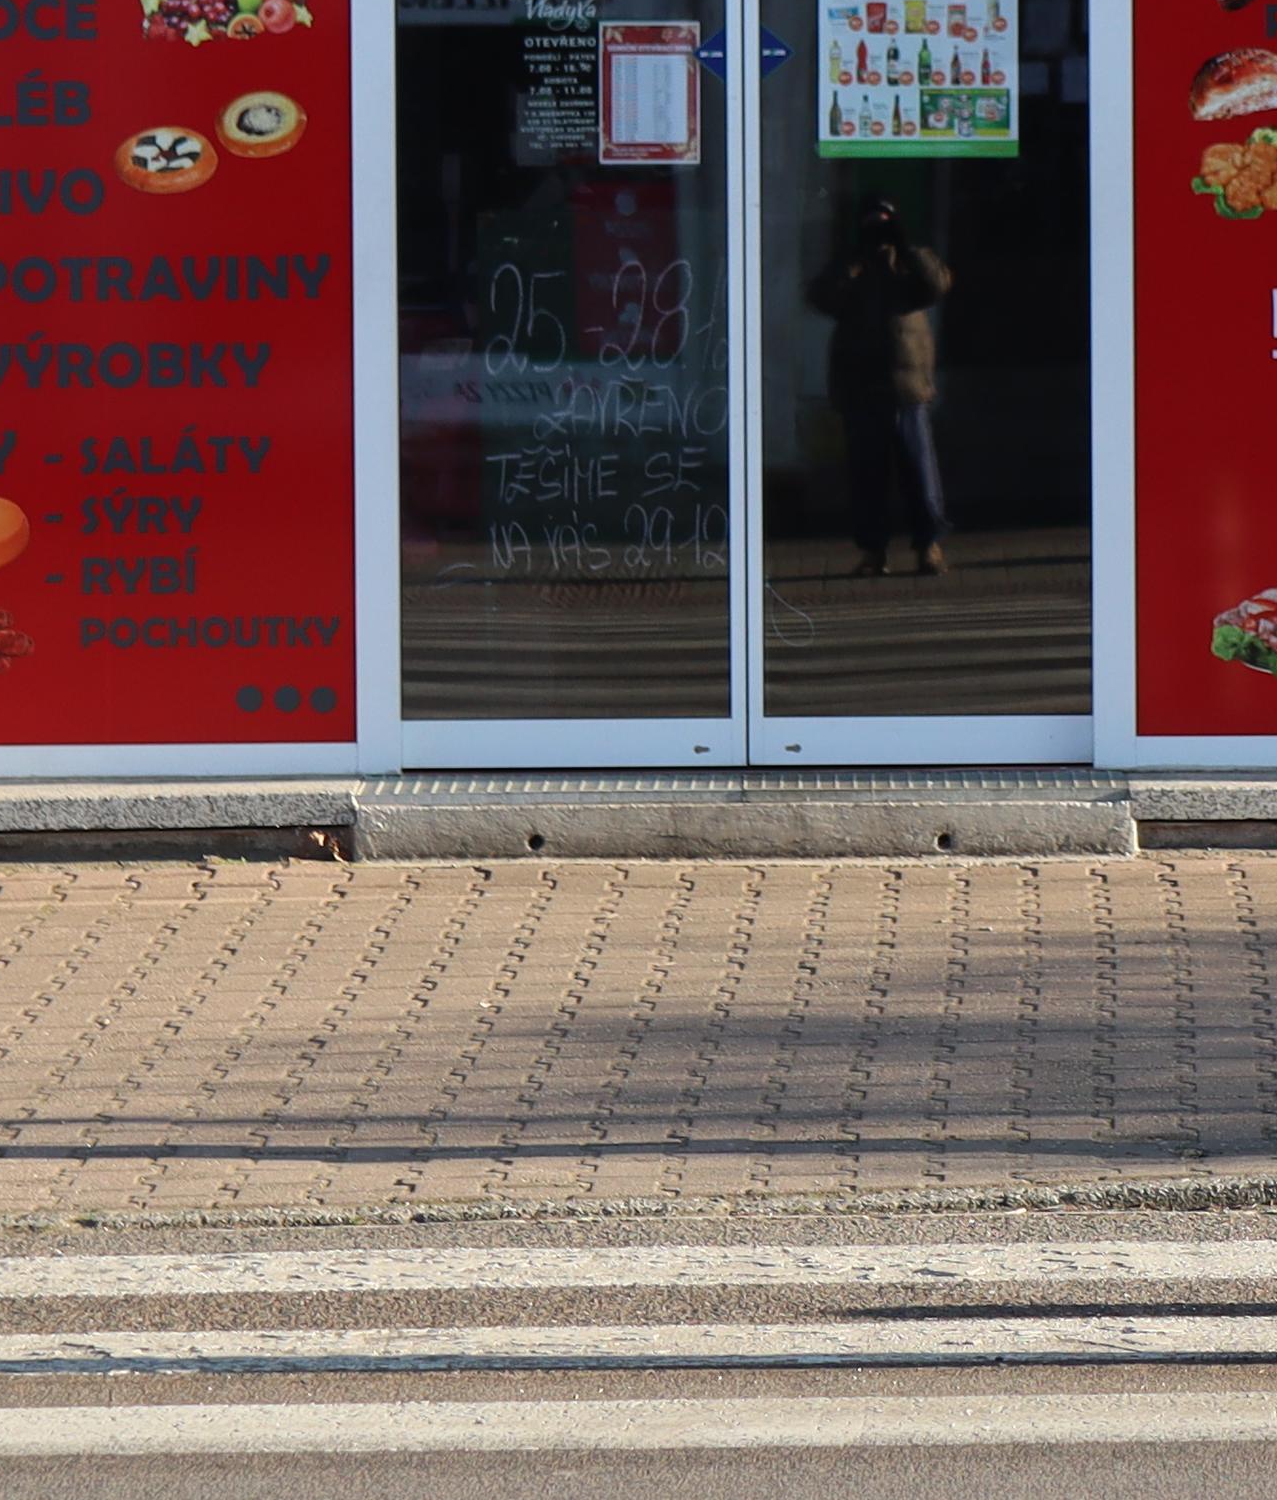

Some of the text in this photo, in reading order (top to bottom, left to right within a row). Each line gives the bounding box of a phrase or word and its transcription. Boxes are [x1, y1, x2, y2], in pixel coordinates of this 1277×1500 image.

[524, 35, 596, 48] OTEVŘENO
[80, 425, 272, 475] SALÁTY
[642, 446, 707, 496] SE
[80, 487, 203, 535] SÝRY
[491, 521, 532, 569] NA
[80, 546, 198, 596] RYBÍ
[79, 615, 340, 650] POCHOUTKY
